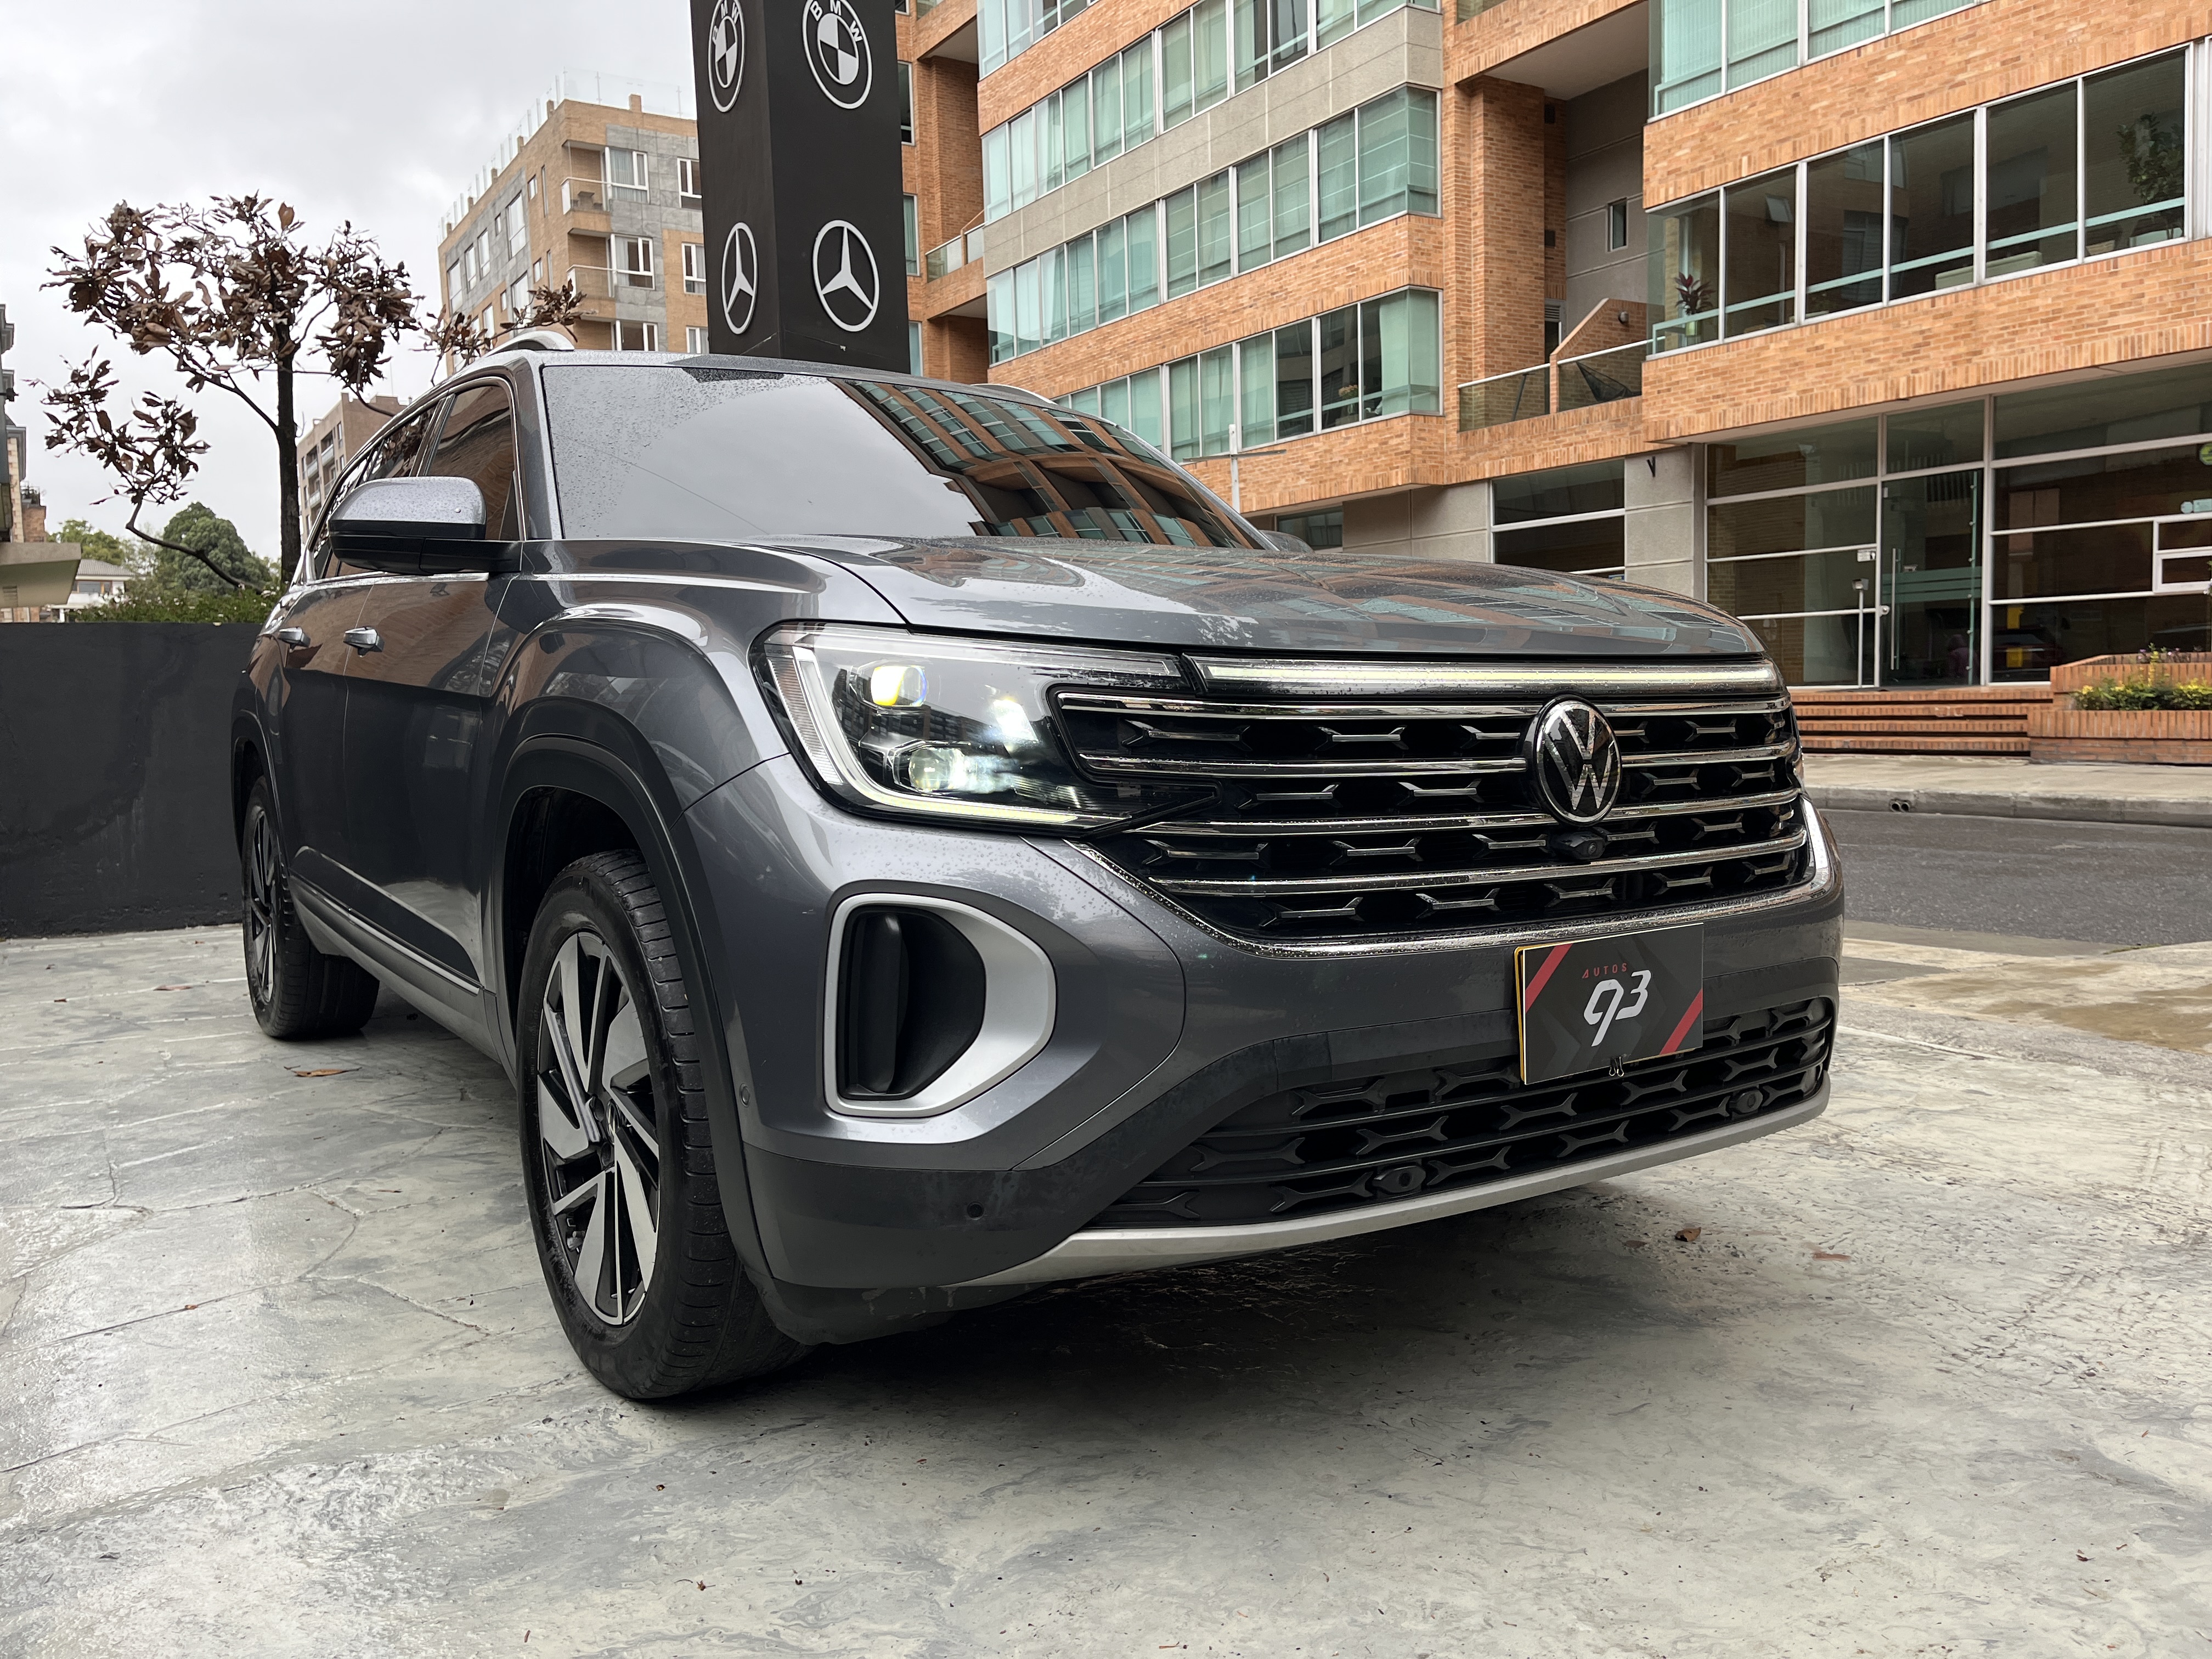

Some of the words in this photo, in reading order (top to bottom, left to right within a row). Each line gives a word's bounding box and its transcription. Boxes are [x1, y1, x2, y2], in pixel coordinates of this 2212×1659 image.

[712, 0, 740, 45] BMW
[810, 0, 863, 42] BMW
[1543, 704, 1615, 810] VW
[1582, 962, 1628, 979] AUTOS
[1583, 969, 1652, 1047] 93
